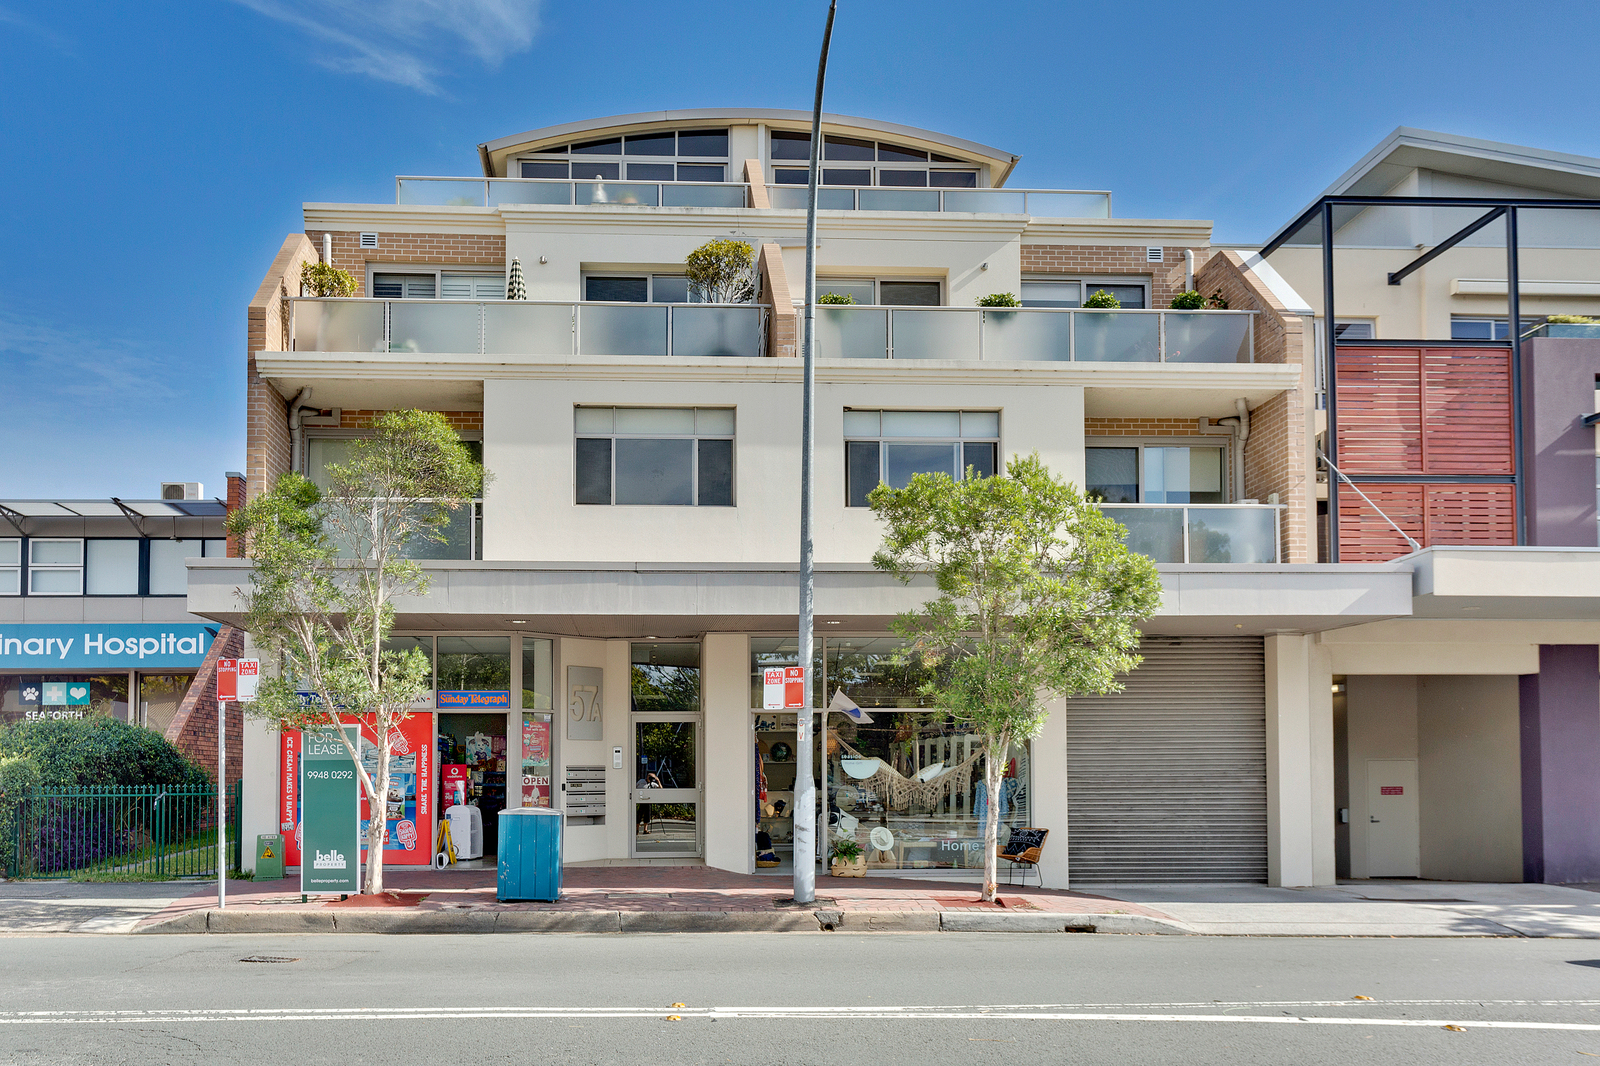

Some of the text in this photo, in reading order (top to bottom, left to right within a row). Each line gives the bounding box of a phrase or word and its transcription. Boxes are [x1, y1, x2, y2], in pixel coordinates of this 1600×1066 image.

[84, 633, 204, 659] Hospital
[789, 669, 799, 677] NO
[440, 694, 507, 705] Sunday Telegraph
[569, 684, 603, 722] 57A
[25, 711, 84, 720] SEAFORTH
[286, 736, 294, 749] ICE
[308, 732, 333, 744] FOR
[308, 744, 344, 755] LEASE
[285, 749, 294, 772] CREAM
[307, 770, 353, 780] 9948 0292
[523, 777, 549, 785] OPEN
[285, 773, 294, 794] MAKES
[420, 778, 428, 793] THE
[420, 793, 428, 815] SHARE
[285, 801, 294, 824] HAPPY
[941, 840, 980, 851] Home
[316, 849, 345, 861] belle
